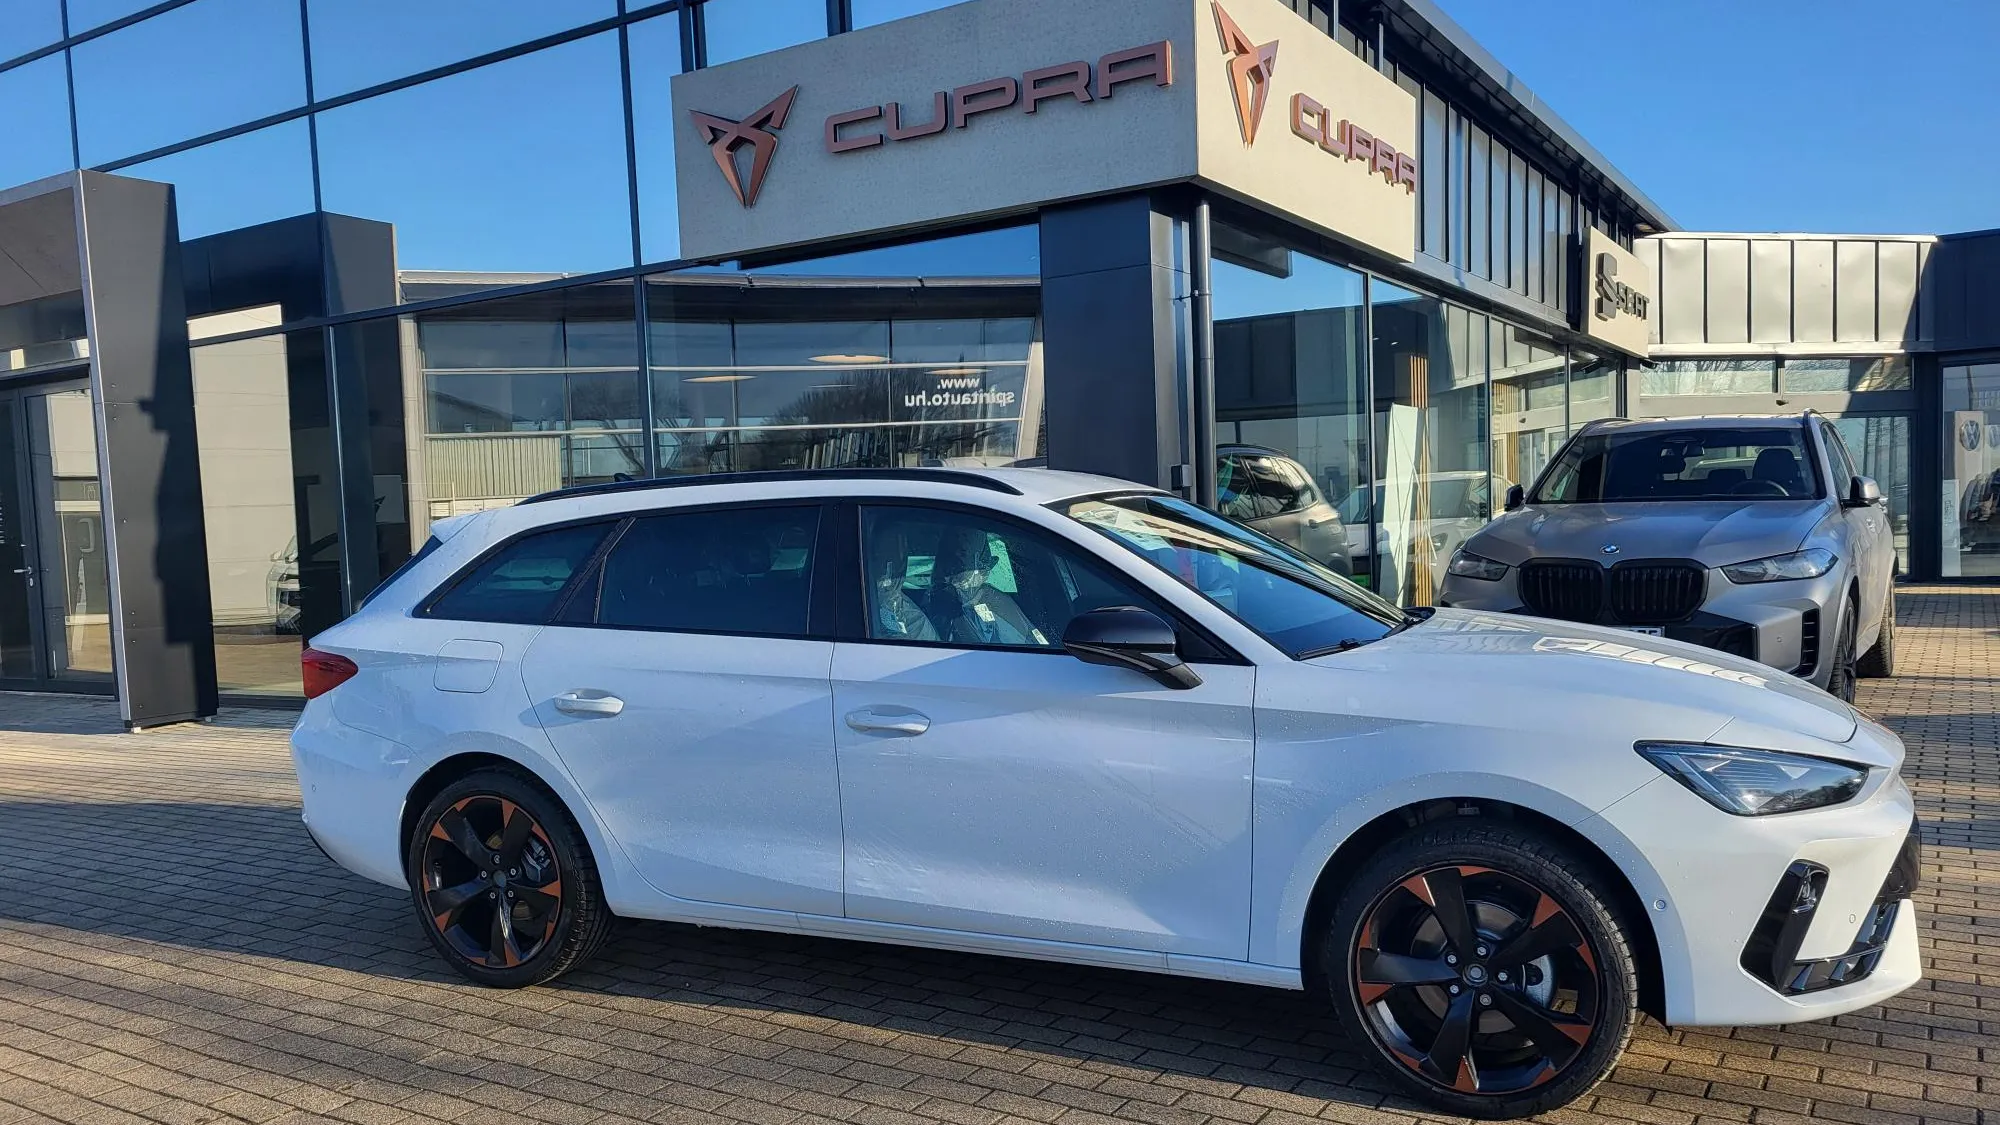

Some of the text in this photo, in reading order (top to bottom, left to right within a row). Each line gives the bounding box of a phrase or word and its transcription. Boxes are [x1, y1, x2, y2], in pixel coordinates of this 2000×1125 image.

[825, 39, 1173, 153] CUPRA
[1291, 92, 1416, 194] CUPRA
[1615, 281, 1650, 321] SEAT
